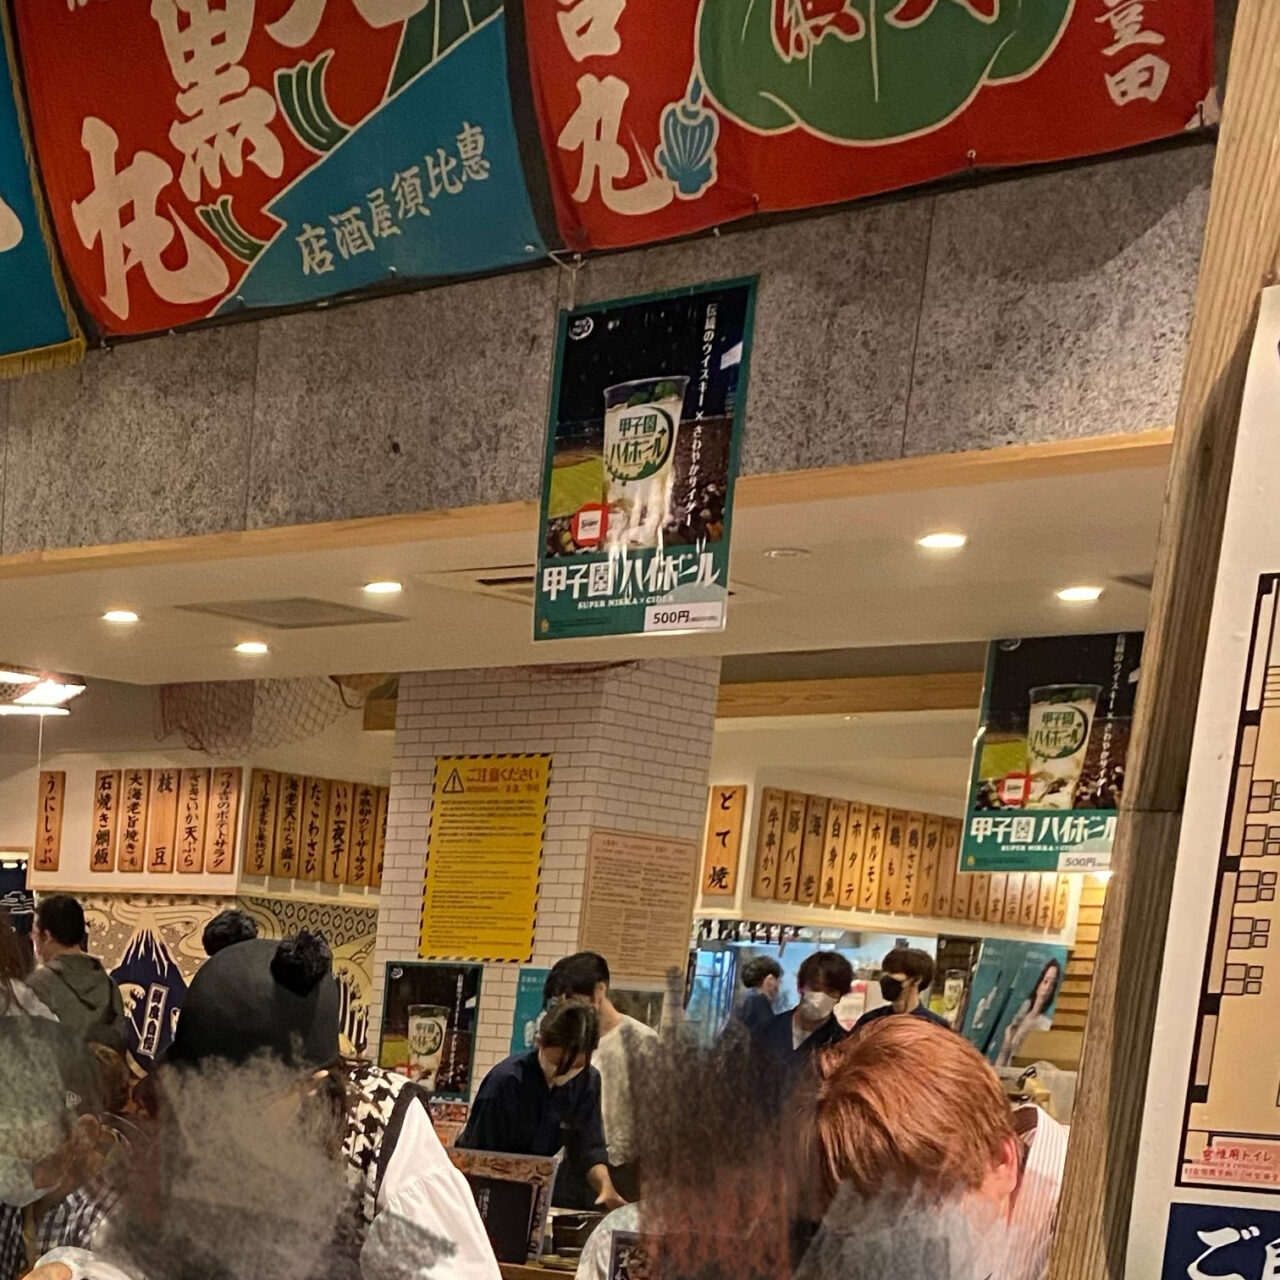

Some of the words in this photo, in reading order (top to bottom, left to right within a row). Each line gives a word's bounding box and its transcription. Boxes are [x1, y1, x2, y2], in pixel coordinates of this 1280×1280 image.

[610, 436, 665, 465] ハイボール
[619, 414, 658, 437] 甲子園
[542, 553, 720, 600] 甲子園ハイボール
[653, 610, 690, 625] 500円
[39, 775, 56, 864] うにしゃぶ
[151, 773, 173, 867] 枝豆
[305, 782, 322, 875] たこわさび
[331, 787, 348, 878] いか一夜干し
[708, 790, 736, 890] どて焼
[823, 815, 841, 898] 白身魚
[845, 820, 862, 900] ホタテ
[865, 823, 881, 903] ホルモン
